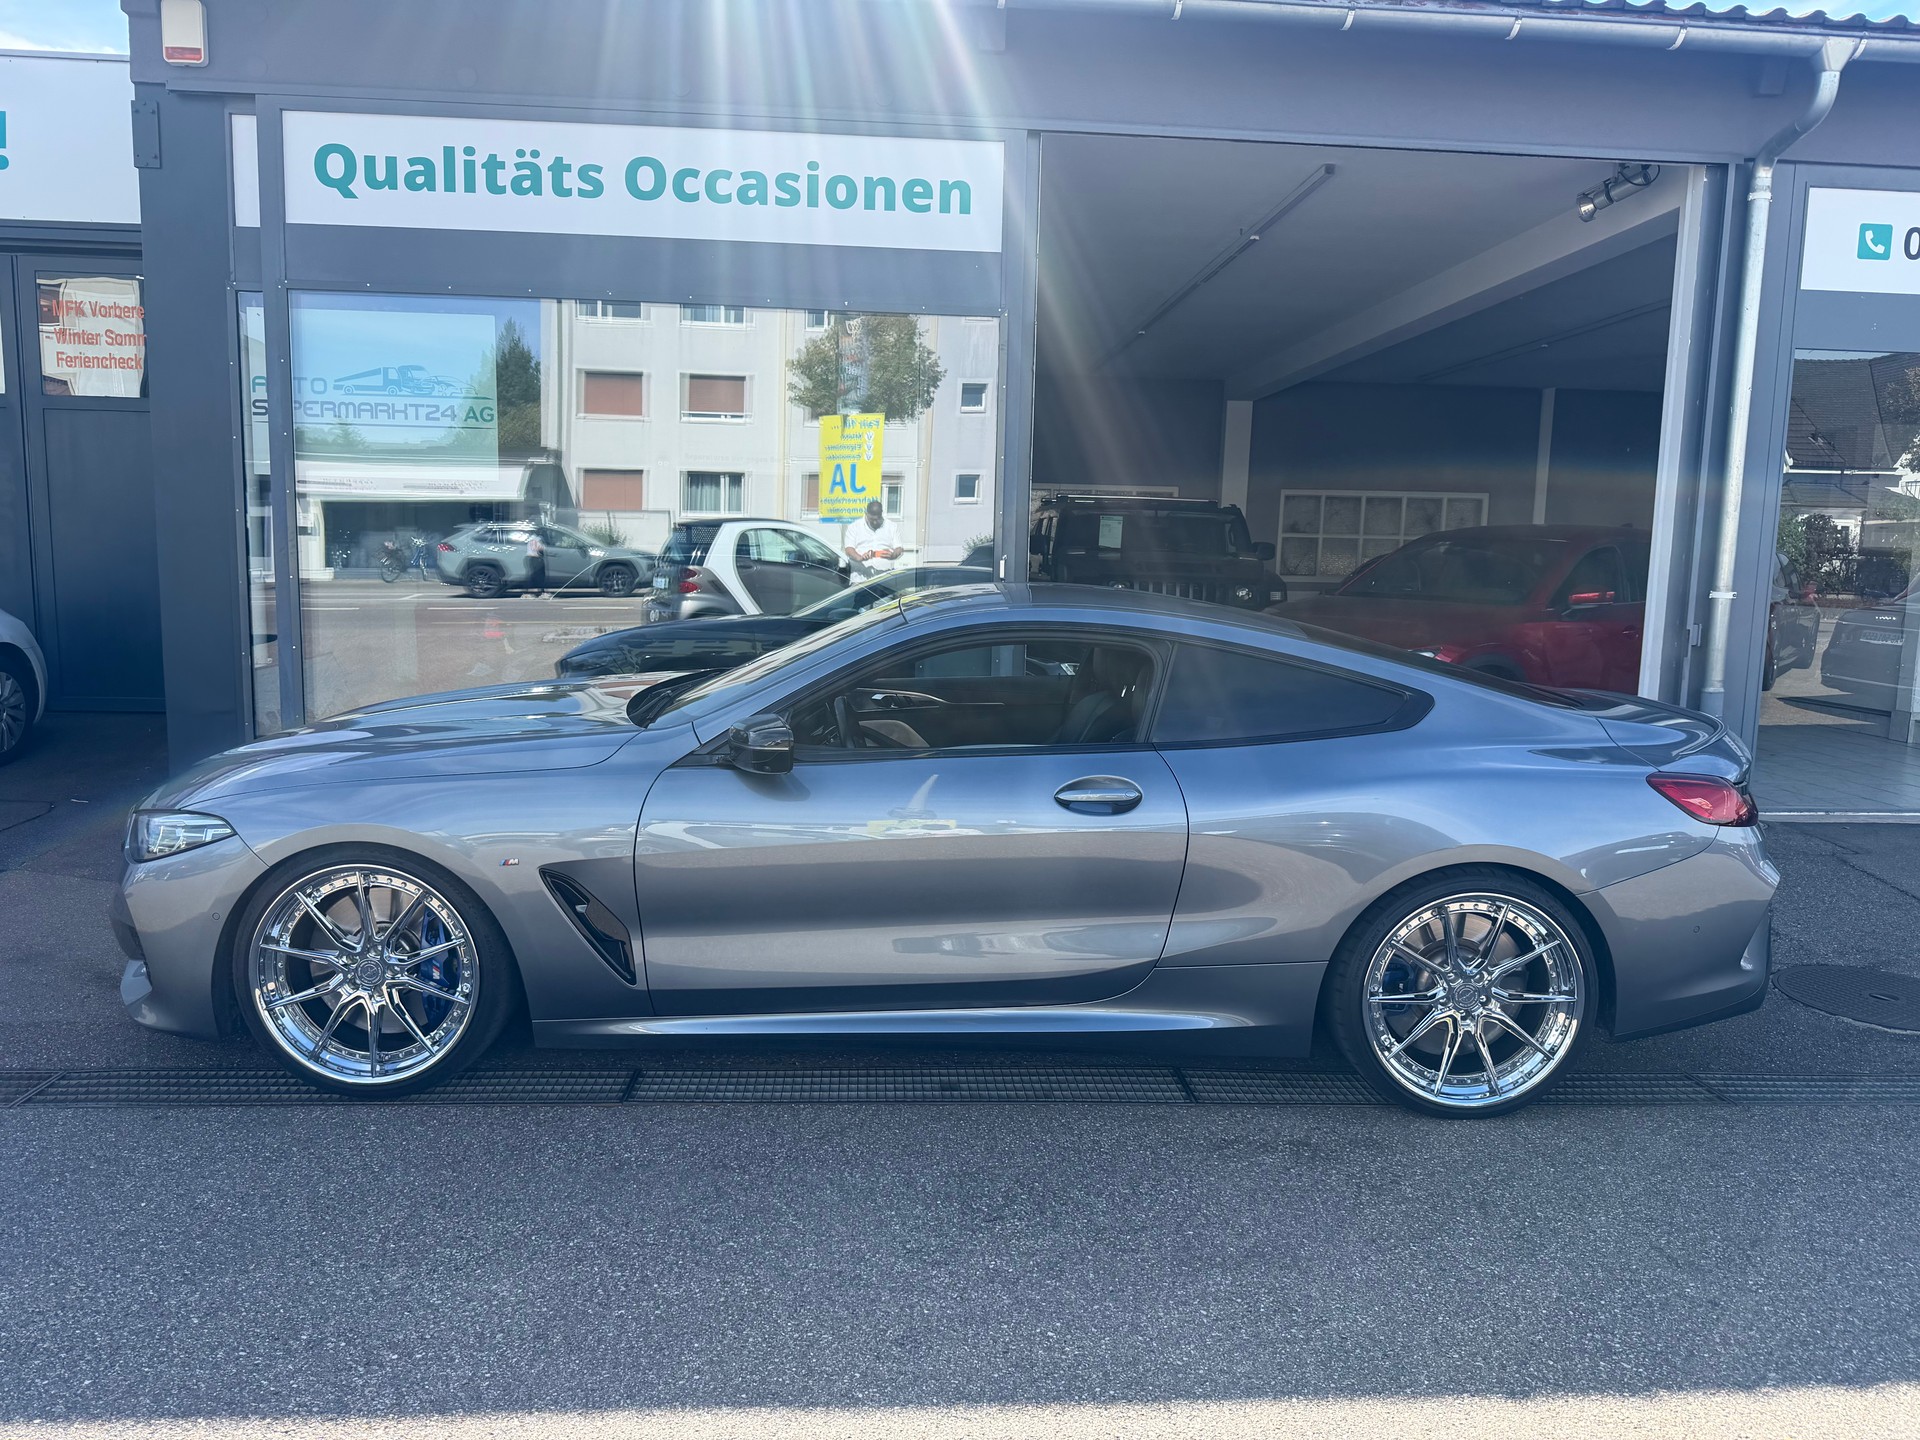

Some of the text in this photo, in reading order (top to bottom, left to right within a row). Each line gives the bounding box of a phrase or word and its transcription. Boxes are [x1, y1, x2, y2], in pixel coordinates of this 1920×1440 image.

[313, 143, 972, 215] Qualitäts Occasionen
[52, 299, 86, 318] MFK
[54, 328, 101, 346] Winter
[56, 351, 143, 370] Feriencheck
[252, 375, 328, 395] ATO
[252, 398, 495, 423] SPERMARKT24 AG
